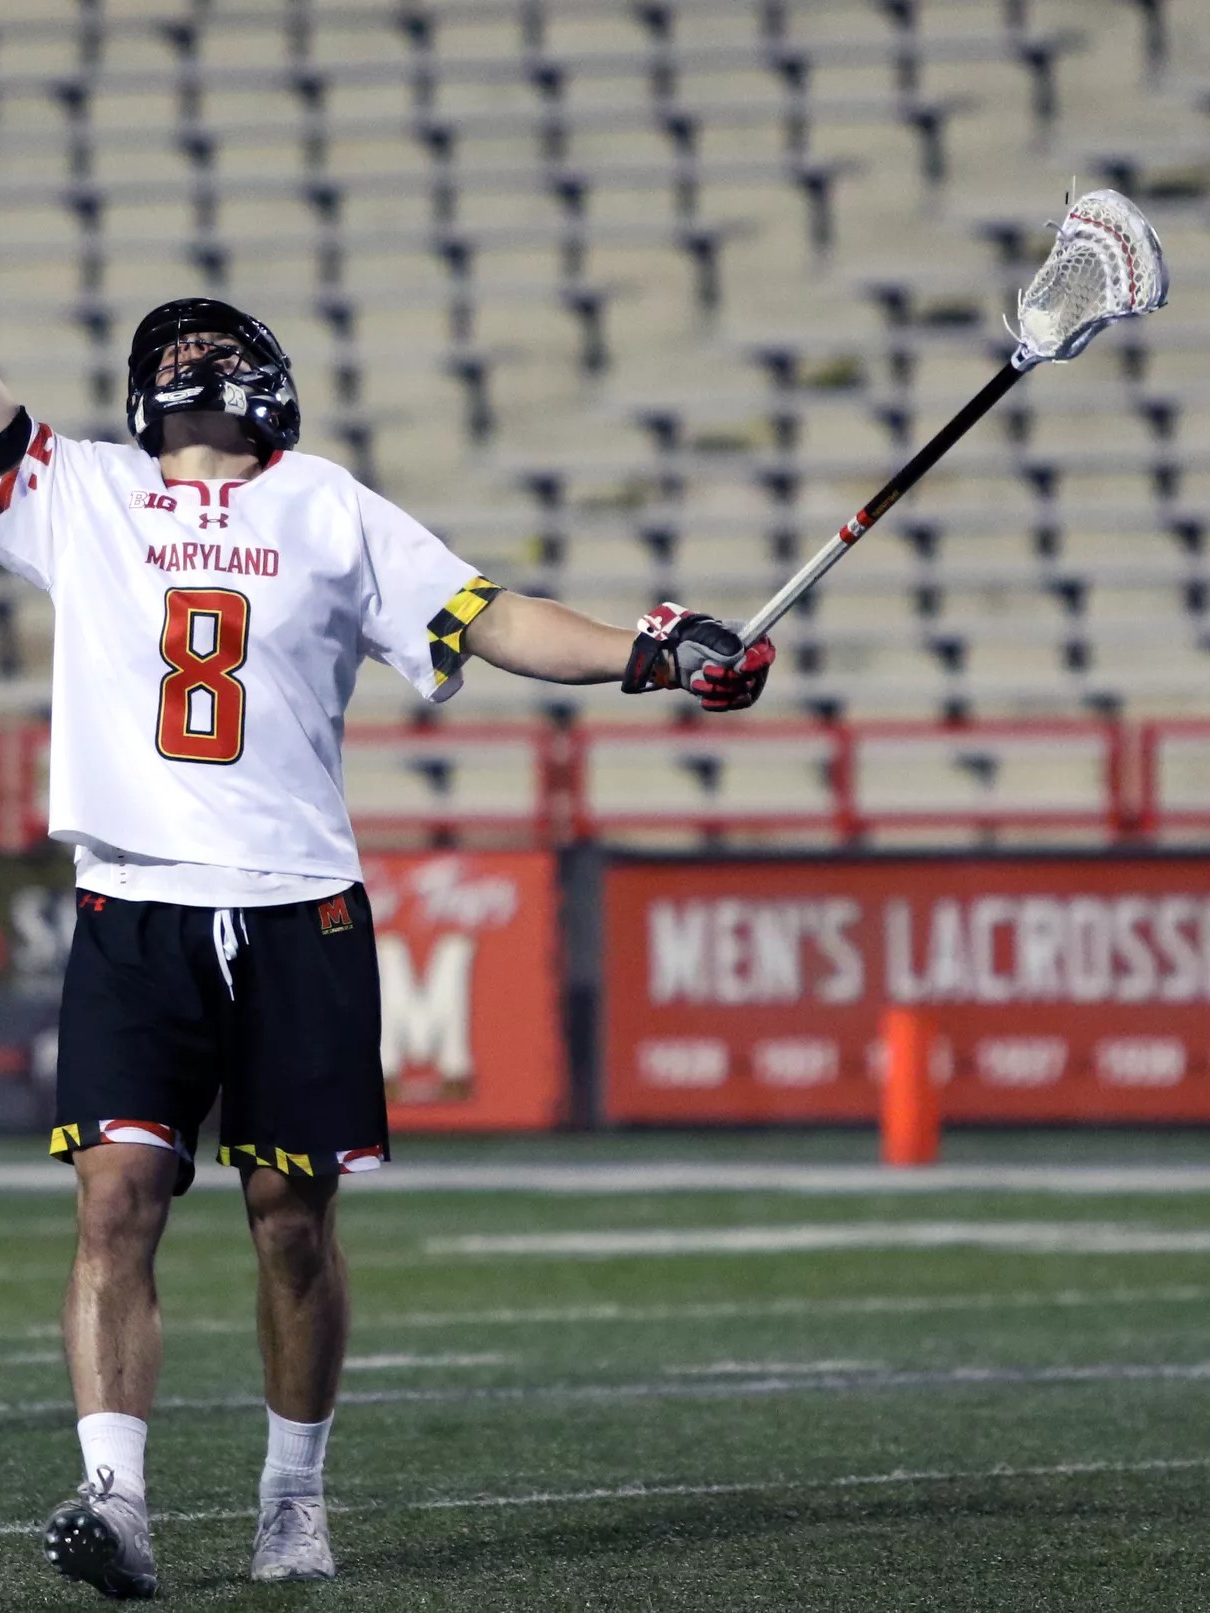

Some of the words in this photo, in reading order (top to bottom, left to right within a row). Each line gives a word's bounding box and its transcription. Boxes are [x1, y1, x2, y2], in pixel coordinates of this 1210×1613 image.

[145, 542, 279, 577] MARYLAND
[156, 586, 250, 765] 8
[649, 896, 865, 1002] MEN'S
[886, 896, 1210, 1002] LACROSS
